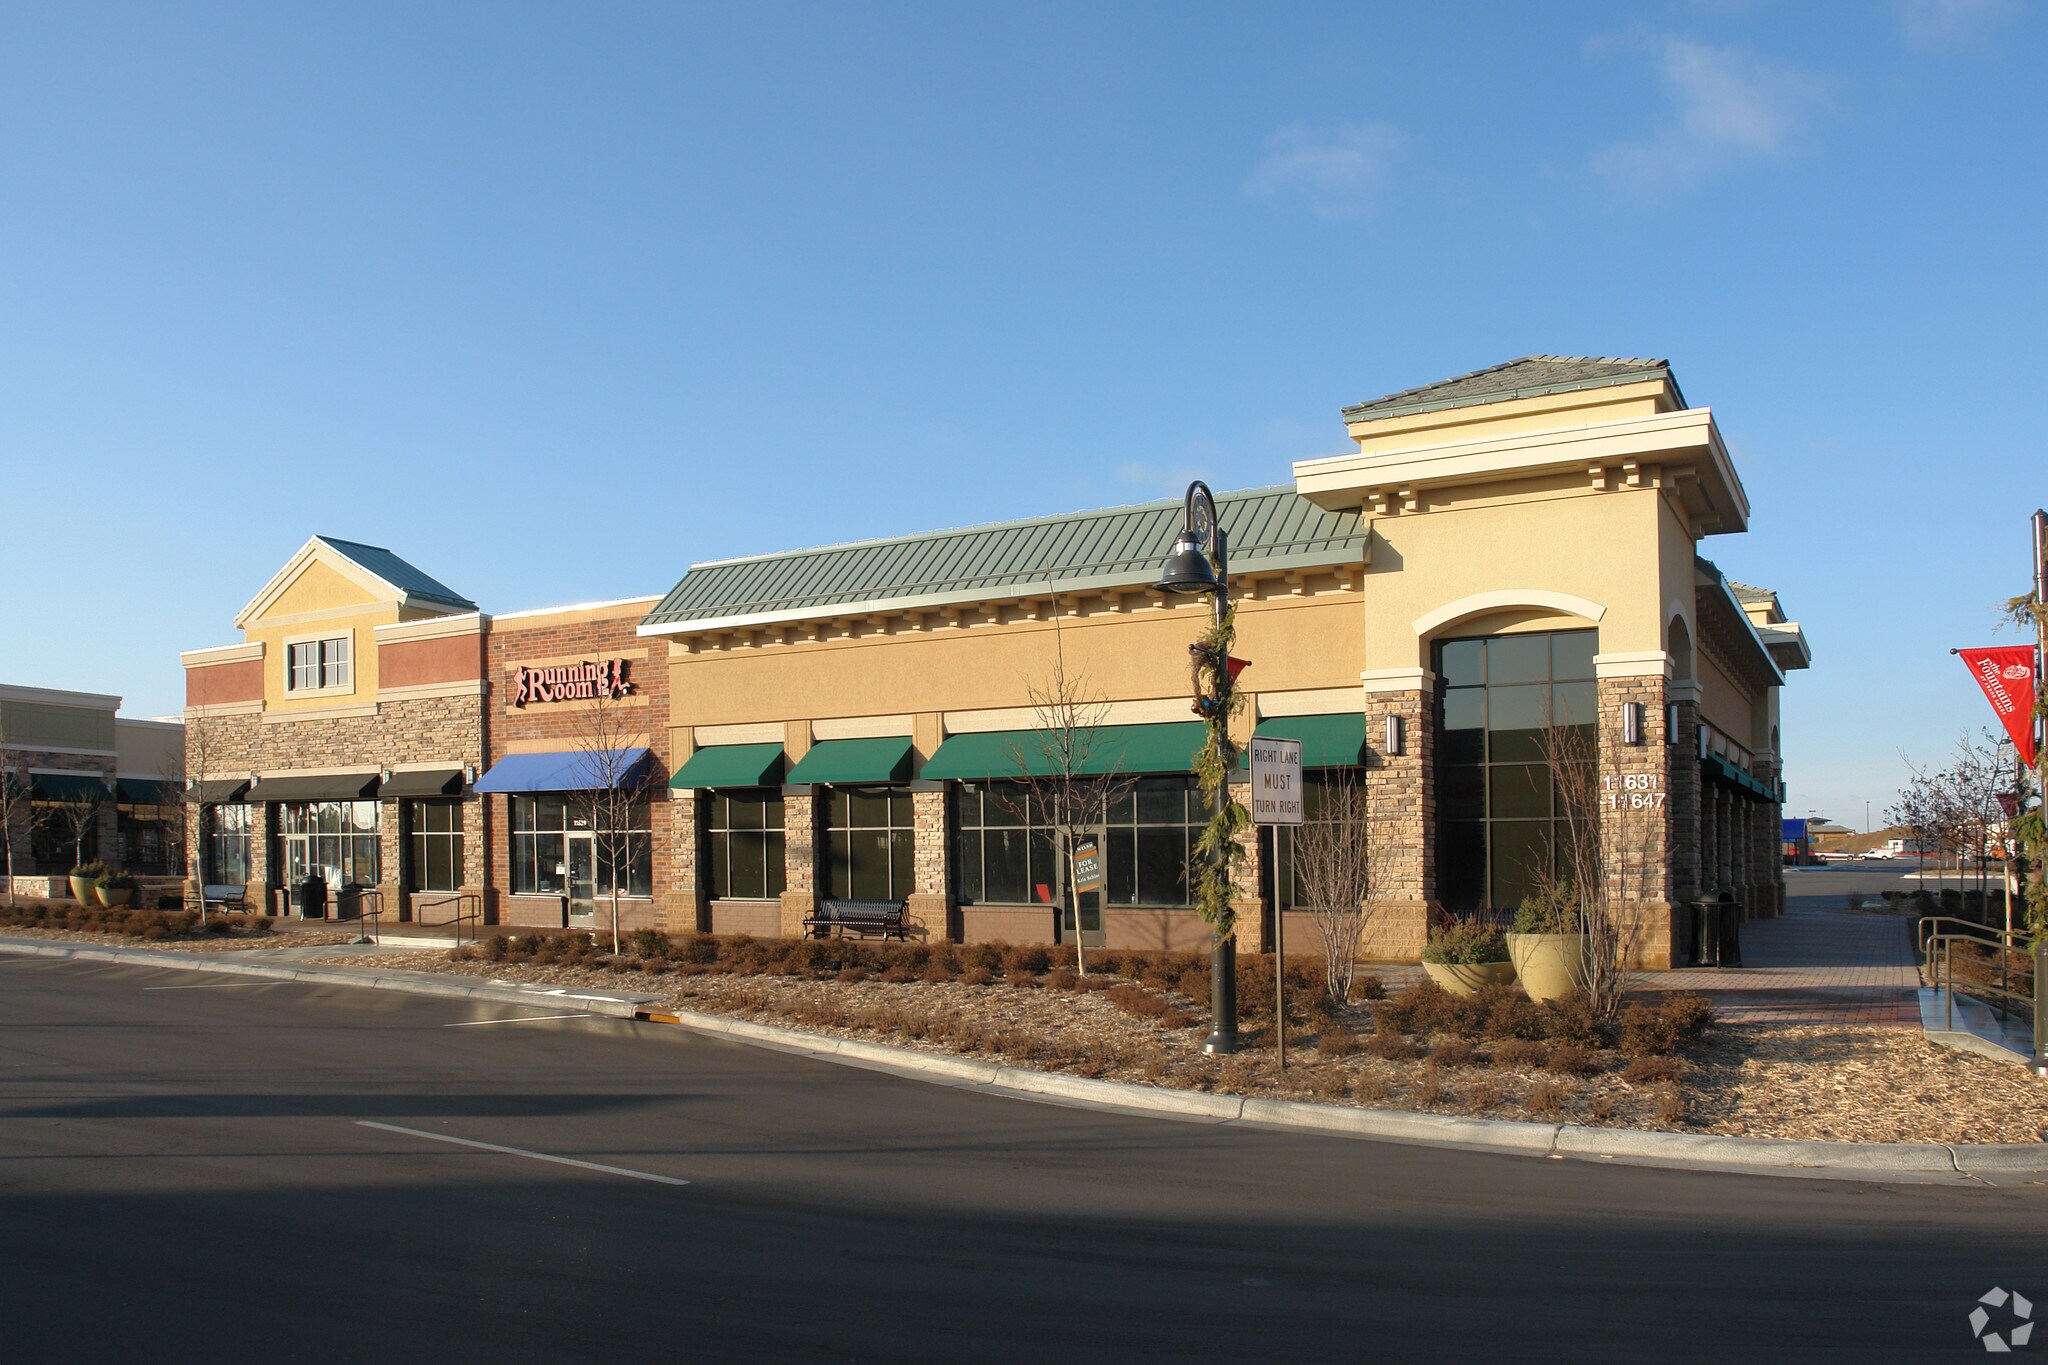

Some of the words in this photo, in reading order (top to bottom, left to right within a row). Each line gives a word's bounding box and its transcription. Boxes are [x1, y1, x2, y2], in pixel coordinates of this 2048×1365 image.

[527, 660, 609, 702] Running
[1977, 658, 2015, 712] Fountains
[1254, 749, 1277, 763] RIGHT
[1280, 751, 1298, 765] LANE
[1264, 773, 1291, 790] MUST
[1603, 774, 1658, 790] 11631
[1255, 800, 1276, 813] TURN
[1280, 801, 1300, 814] RIGHT
[1076, 864, 1098, 875] LEASE
[1078, 859, 1092, 868] FOR
